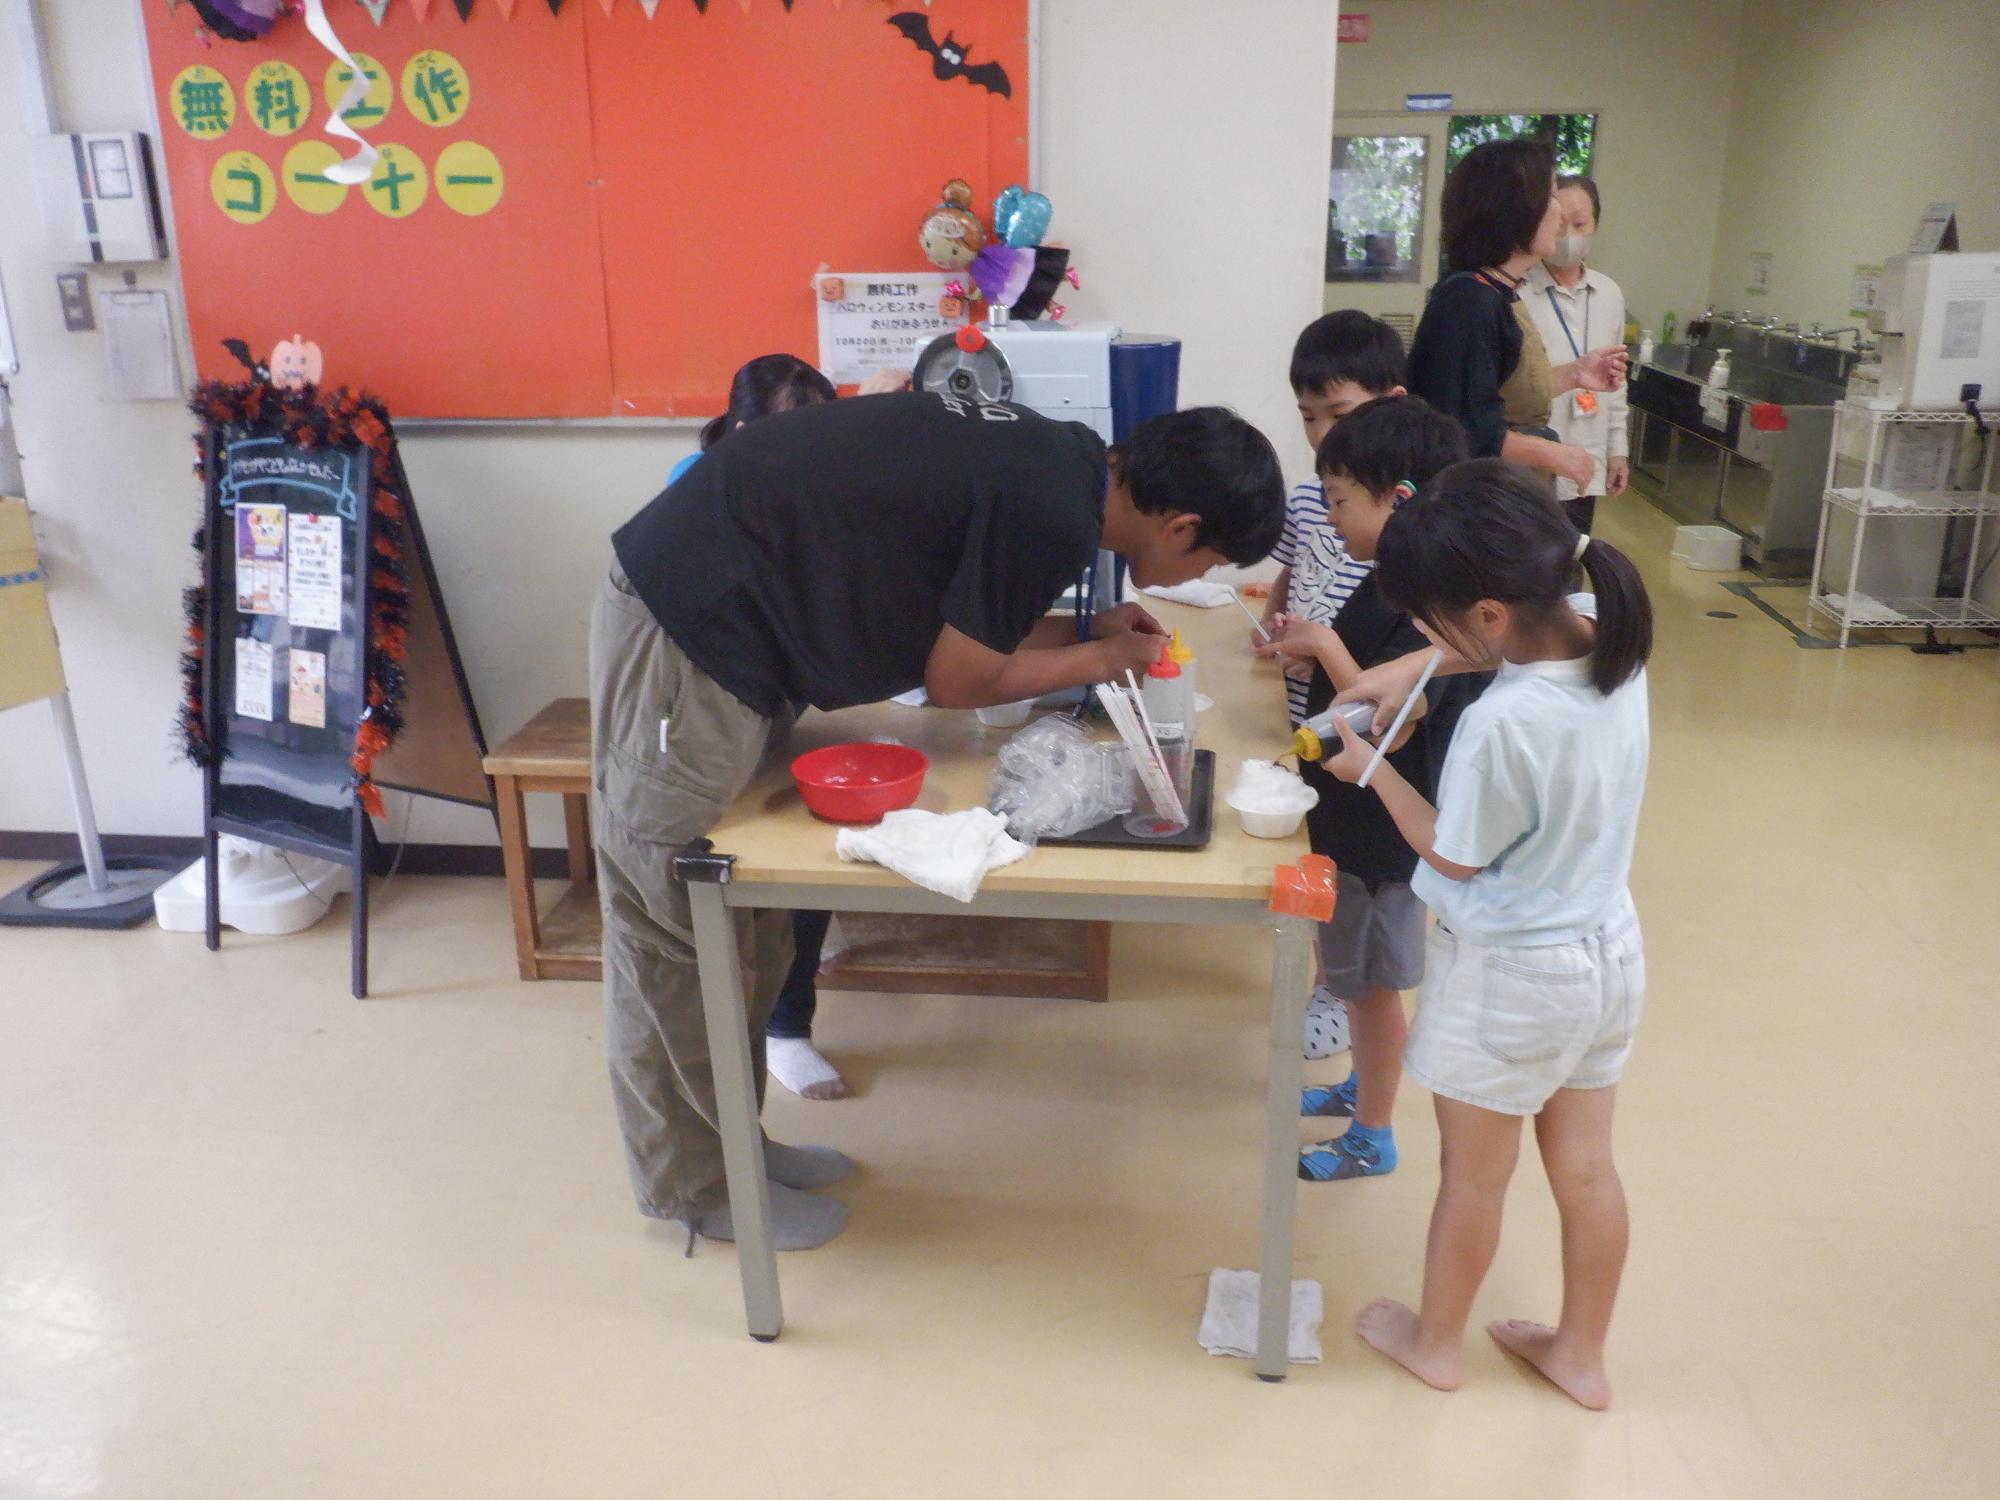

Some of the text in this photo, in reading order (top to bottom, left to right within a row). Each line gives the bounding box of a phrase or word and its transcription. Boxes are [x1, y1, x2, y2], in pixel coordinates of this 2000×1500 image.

[179, 66, 462, 132] 無料工作
[225, 162, 493, 213] コーナー
